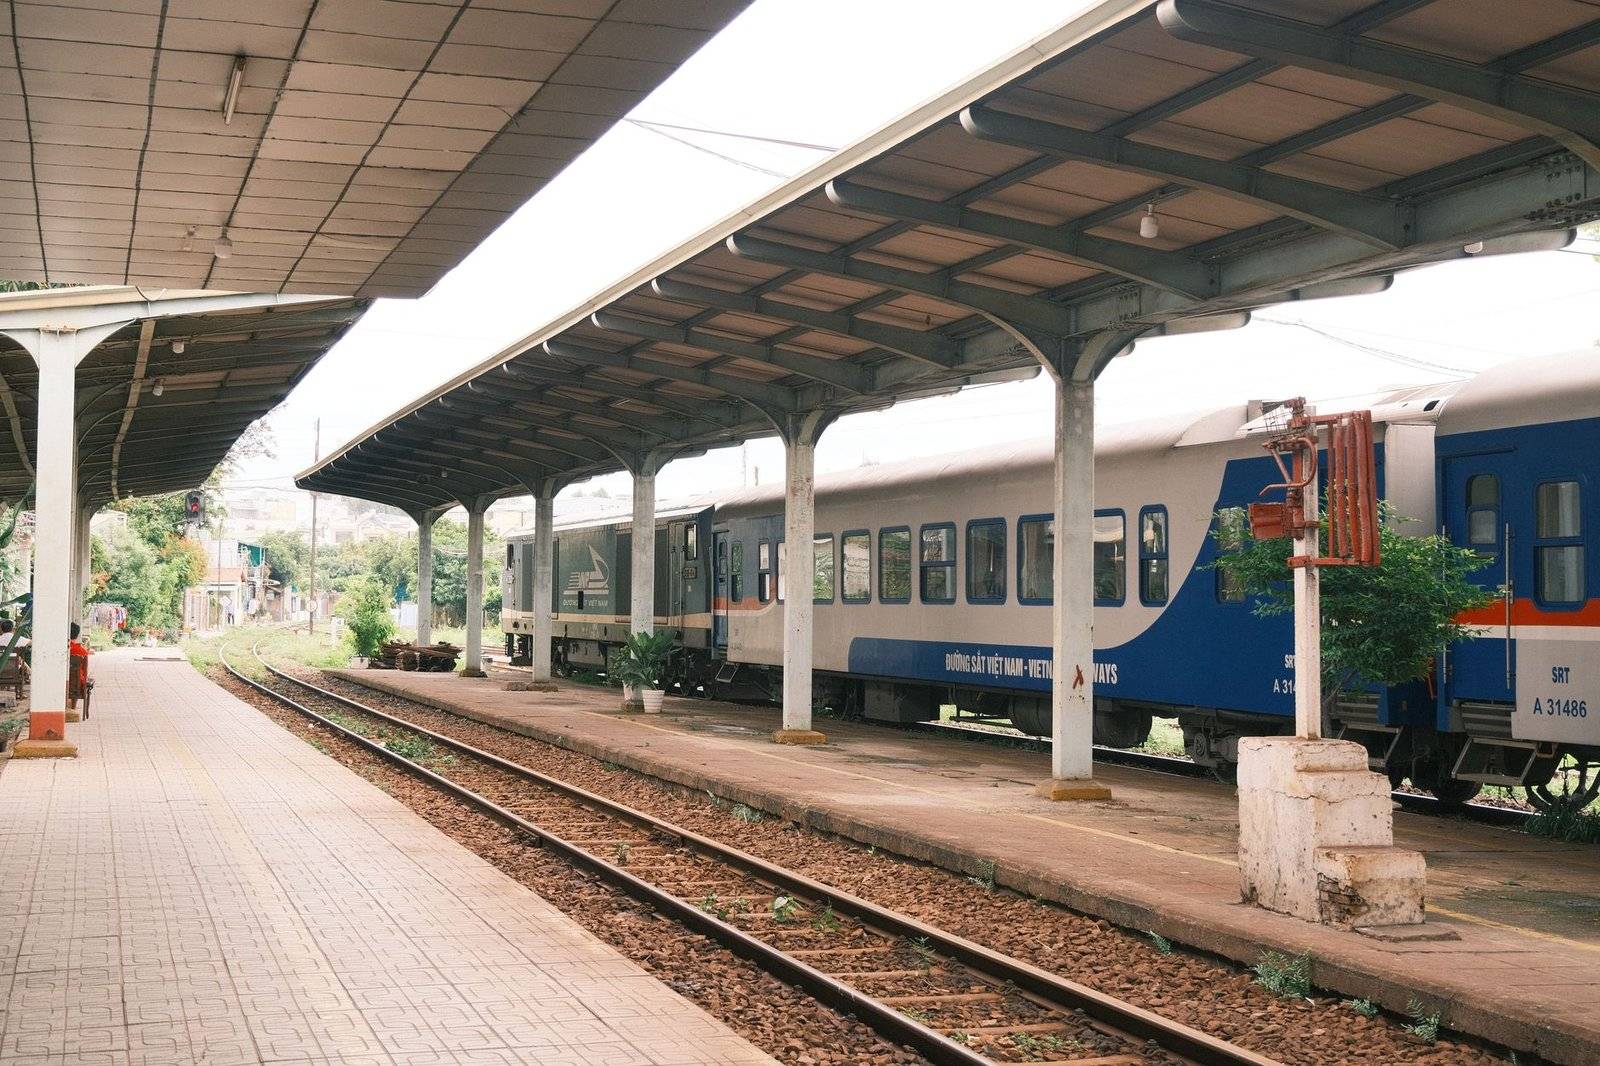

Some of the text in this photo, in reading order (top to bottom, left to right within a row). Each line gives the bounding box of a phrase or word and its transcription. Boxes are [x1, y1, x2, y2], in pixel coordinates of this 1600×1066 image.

[987, 652, 1003, 679] VIỆT
[1004, 657, 1023, 676] NAM
[1028, 658, 1053, 679] VIETN
[1551, 666, 1570, 684] SRT
[1273, 679, 1280, 693] A
[1533, 697, 1587, 718] A 31486
